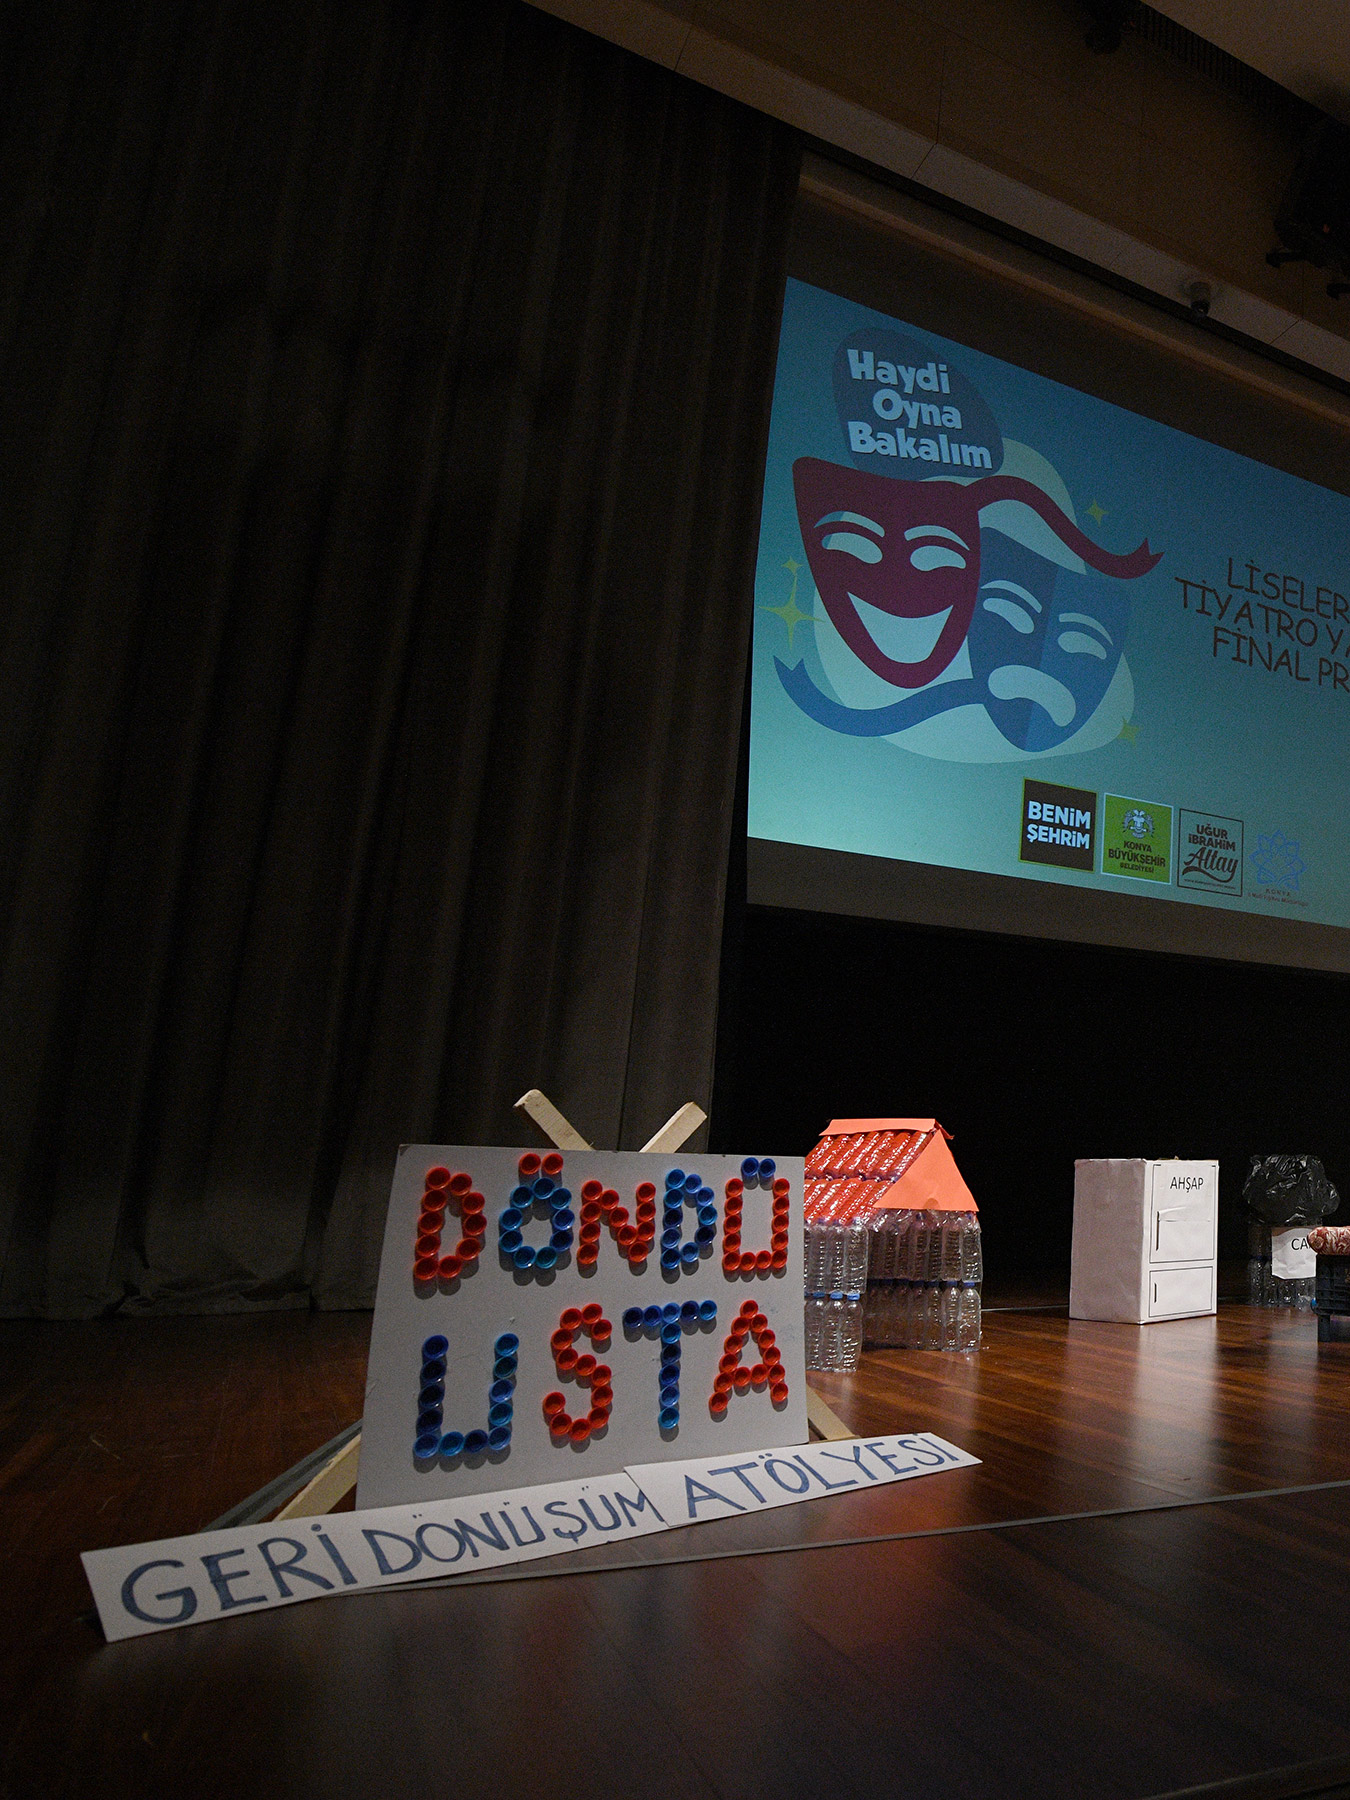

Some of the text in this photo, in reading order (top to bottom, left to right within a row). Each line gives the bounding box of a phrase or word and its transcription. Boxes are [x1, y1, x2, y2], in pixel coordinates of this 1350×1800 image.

[847, 349, 951, 395] Haydi
[872, 388, 963, 430] Oyna
[847, 420, 993, 469] Bakalım
[1227, 557, 1350, 624] LİSELER
[1174, 576, 1318, 647] TİYATRO
[1213, 625, 1311, 682] FİNAL
[1028, 800, 1091, 829] BENİM
[1197, 823, 1228, 839] UĞUR
[1026, 823, 1090, 849] ŞEHRİM
[1124, 841, 1152, 853] KONYA
[1188, 833, 1236, 851] İBRAHİM
[1108, 848, 1166, 867] BÜYÜKŞEHİR
[1182, 847, 1239, 883] Altay
[1170, 1176, 1204, 1193] AHŞAP
[413, 1153, 790, 1280] DÖNDÜ
[1291, 1237, 1310, 1251] CA
[413, 1300, 789, 1458] USTA
[121, 1432, 963, 1626] GERİ DÖNÜŞÜM ATÖLYESİ
